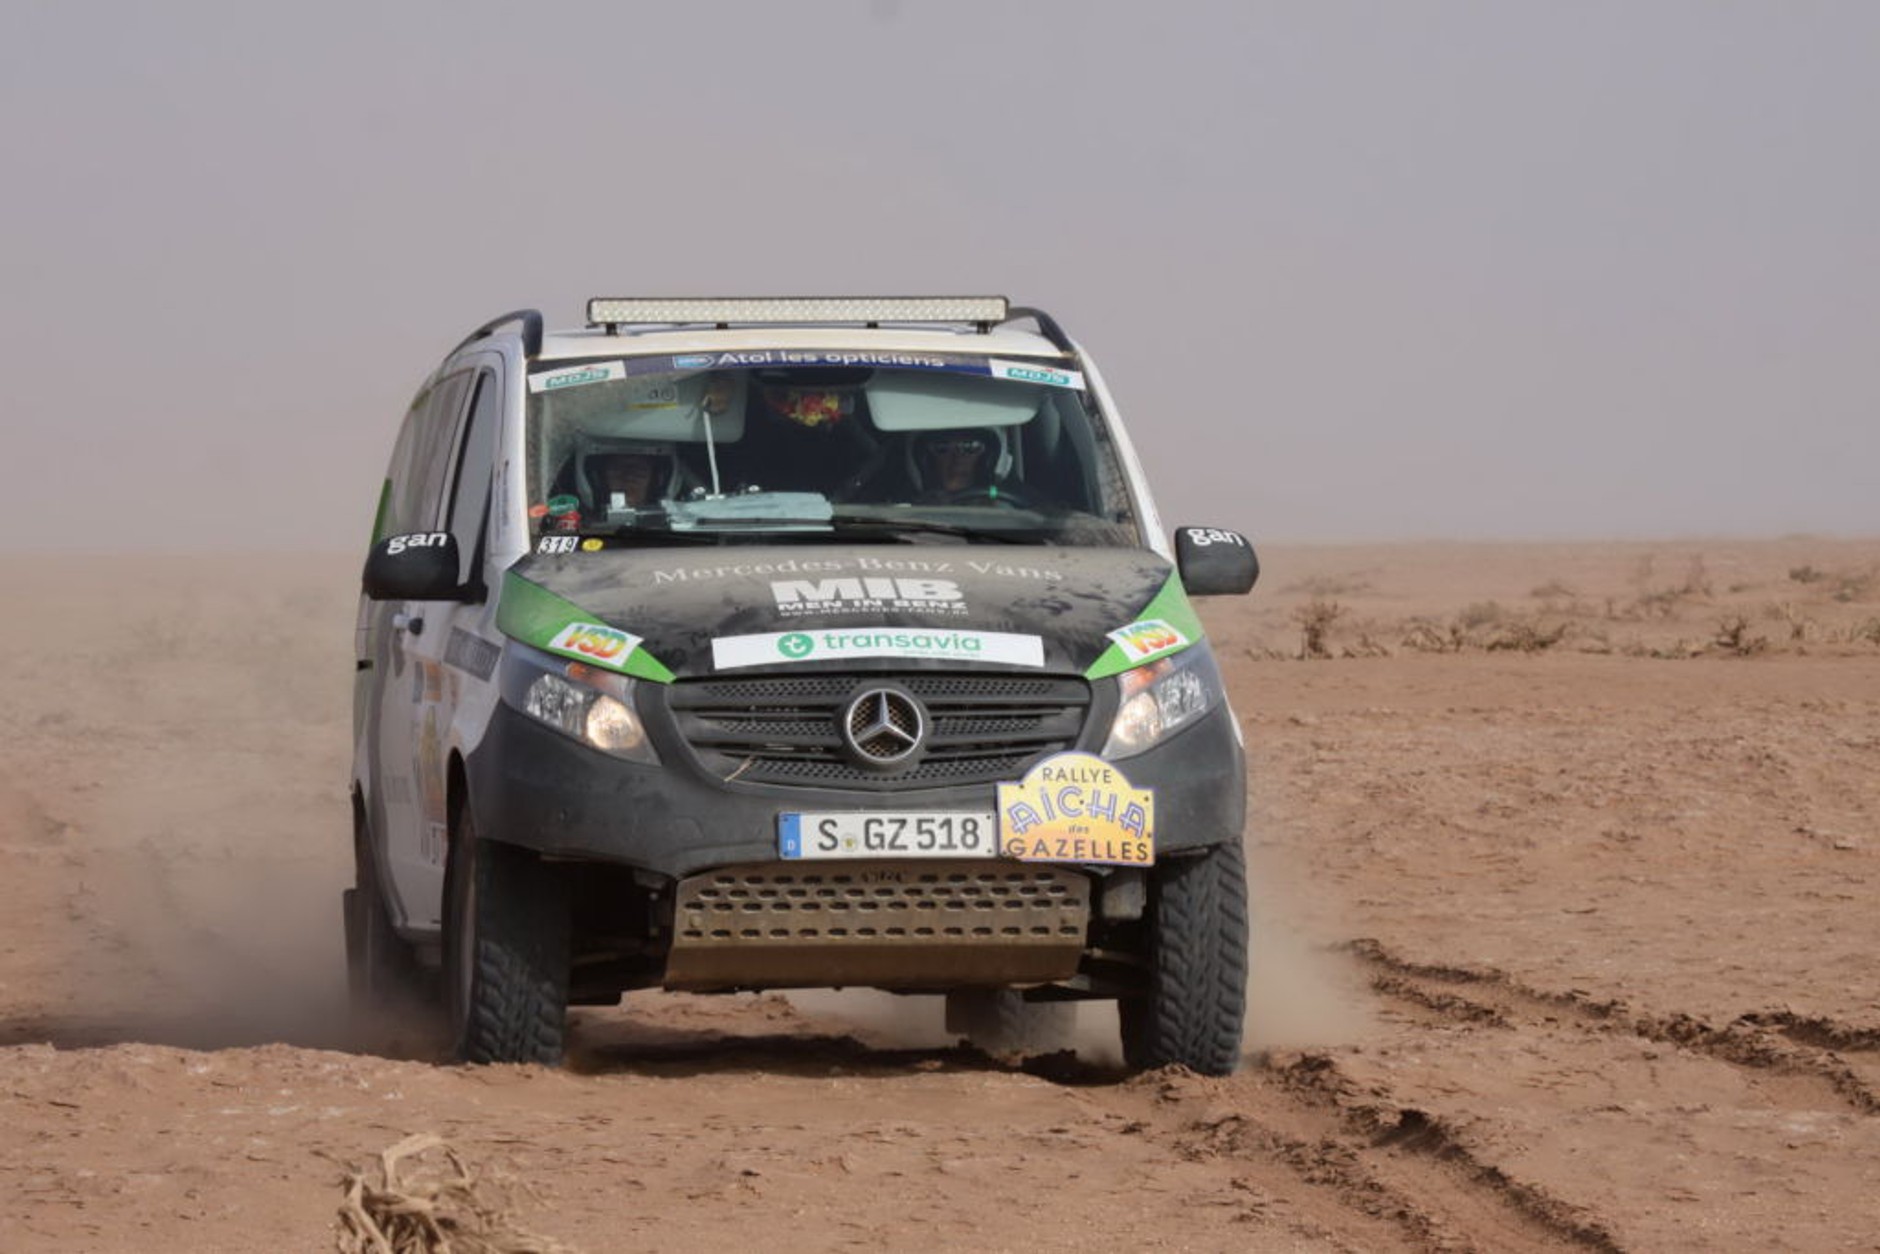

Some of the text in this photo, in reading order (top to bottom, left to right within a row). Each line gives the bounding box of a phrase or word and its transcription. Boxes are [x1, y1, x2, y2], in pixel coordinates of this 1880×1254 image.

[717, 351, 945, 367] Atol les opticiens
[387, 532, 448, 555] gan
[539, 536, 577, 553] 319
[1187, 528, 1245, 547] gan
[964, 560, 1064, 582] Vans
[770, 577, 964, 603] MIB
[777, 599, 968, 612] MEN IN BENZ
[822, 632, 982, 651] transavia
[1042, 767, 1112, 784] RALLYE
[817, 817, 980, 851] S GZ 518
[1006, 838, 1149, 862] GAZELLES
